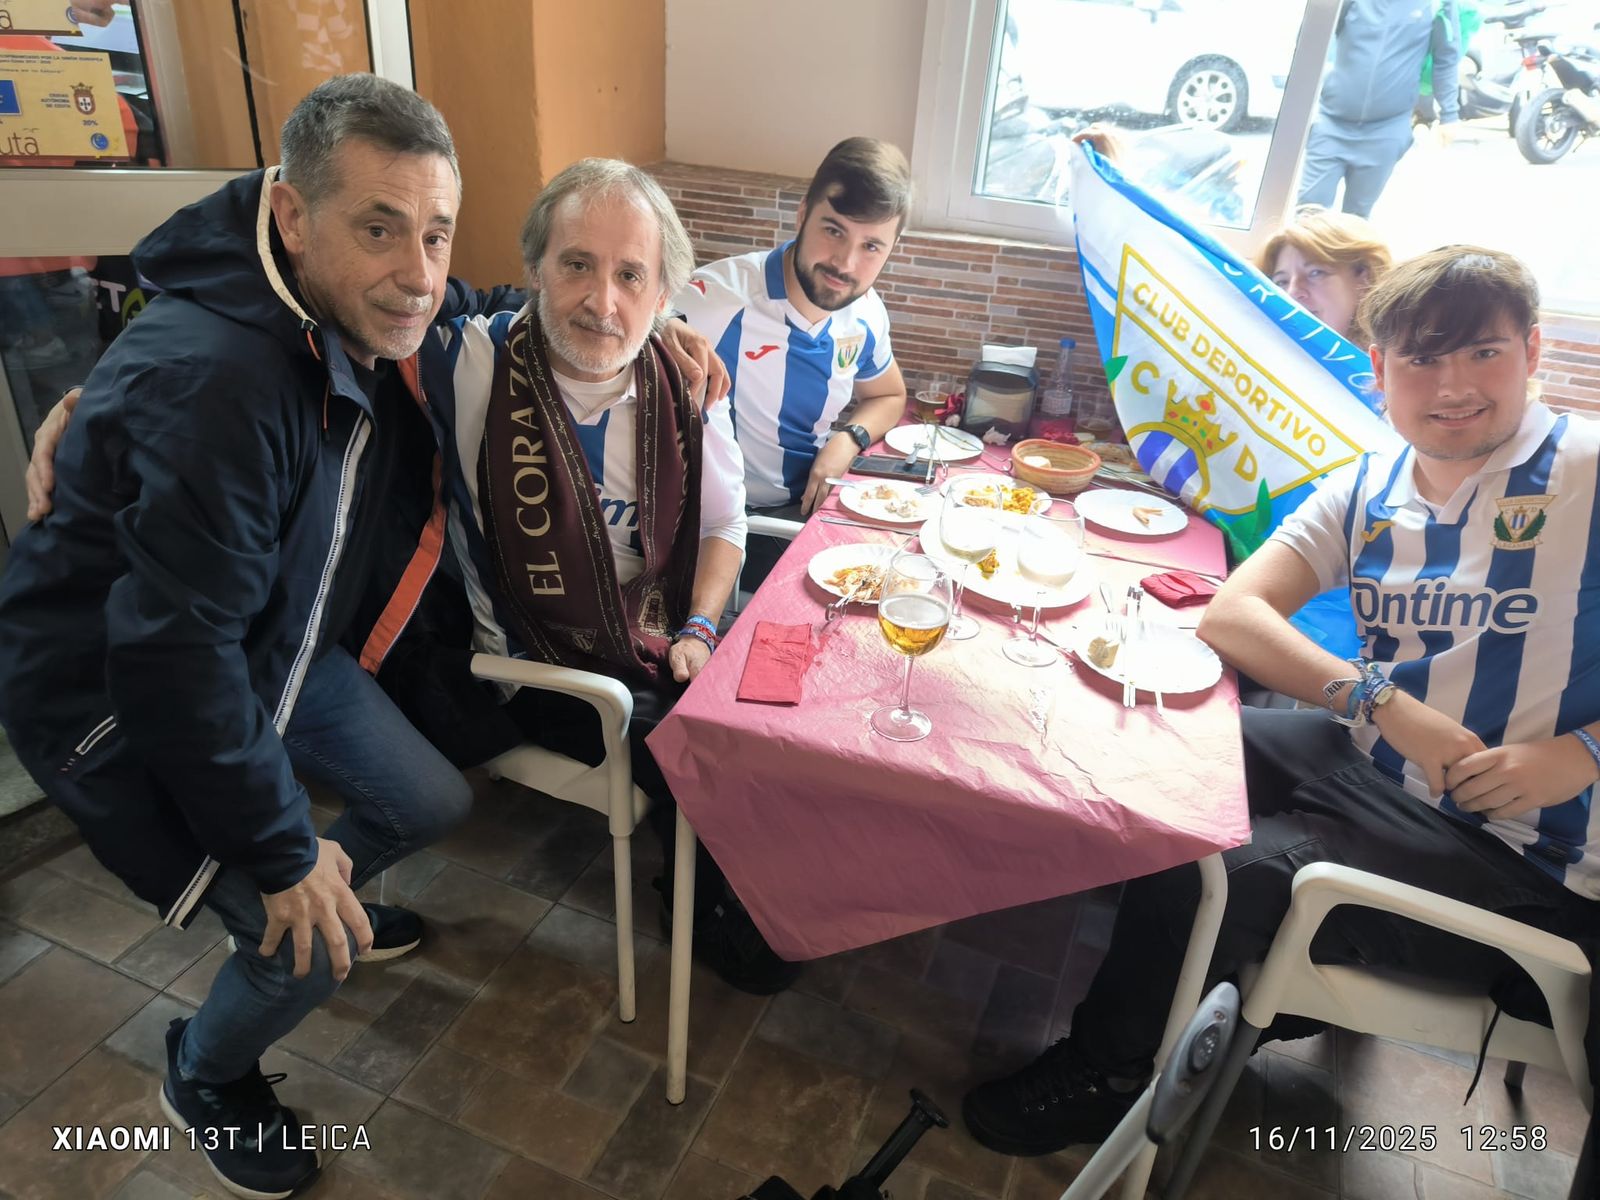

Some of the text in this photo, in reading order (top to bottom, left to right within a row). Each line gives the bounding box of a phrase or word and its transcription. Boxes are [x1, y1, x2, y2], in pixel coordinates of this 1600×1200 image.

[1133, 282, 1327, 457] CLUB DEPORTIVO
[526, 551, 566, 597] EL
[1352, 578, 1538, 629] Ontime
